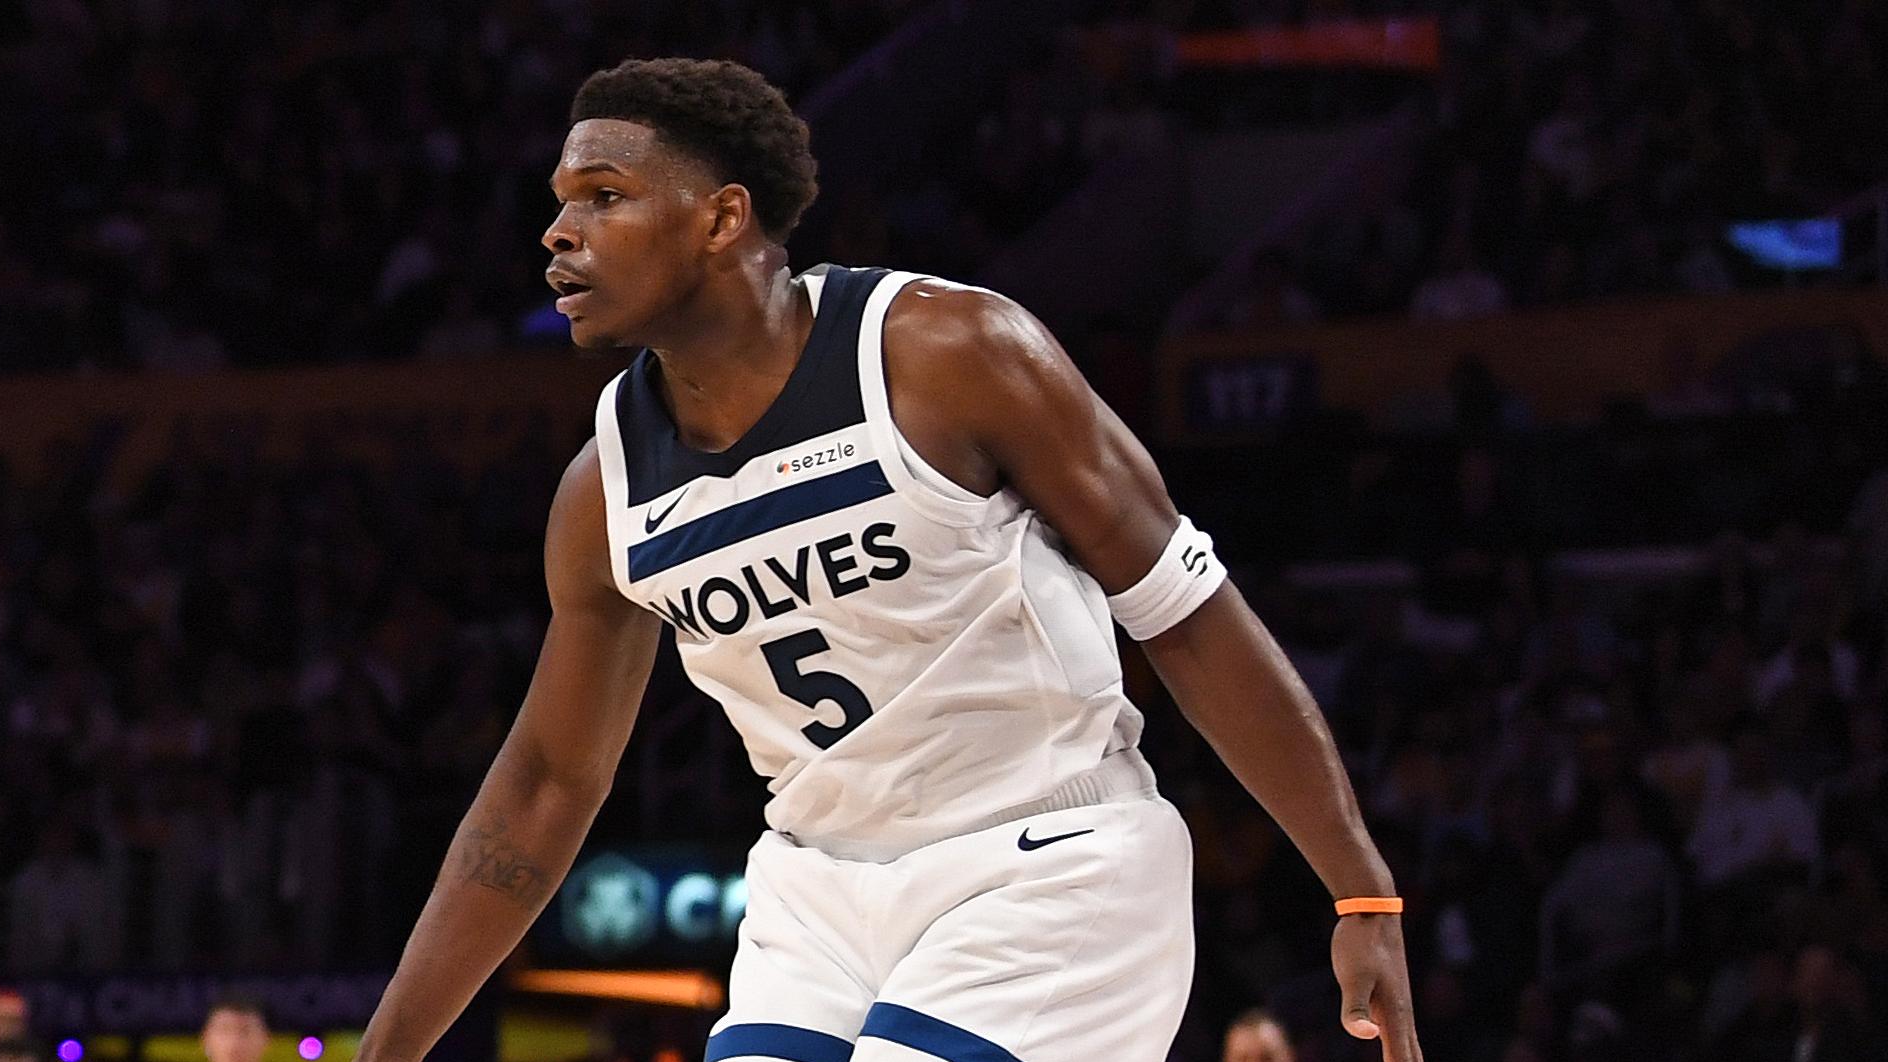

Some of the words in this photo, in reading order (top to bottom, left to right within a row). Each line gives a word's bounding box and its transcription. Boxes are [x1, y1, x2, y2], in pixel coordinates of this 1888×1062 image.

[792, 441, 855, 472] sezzle
[649, 521, 912, 640] WOLVES
[1181, 545, 1208, 579] 5
[759, 627, 874, 752] 5
